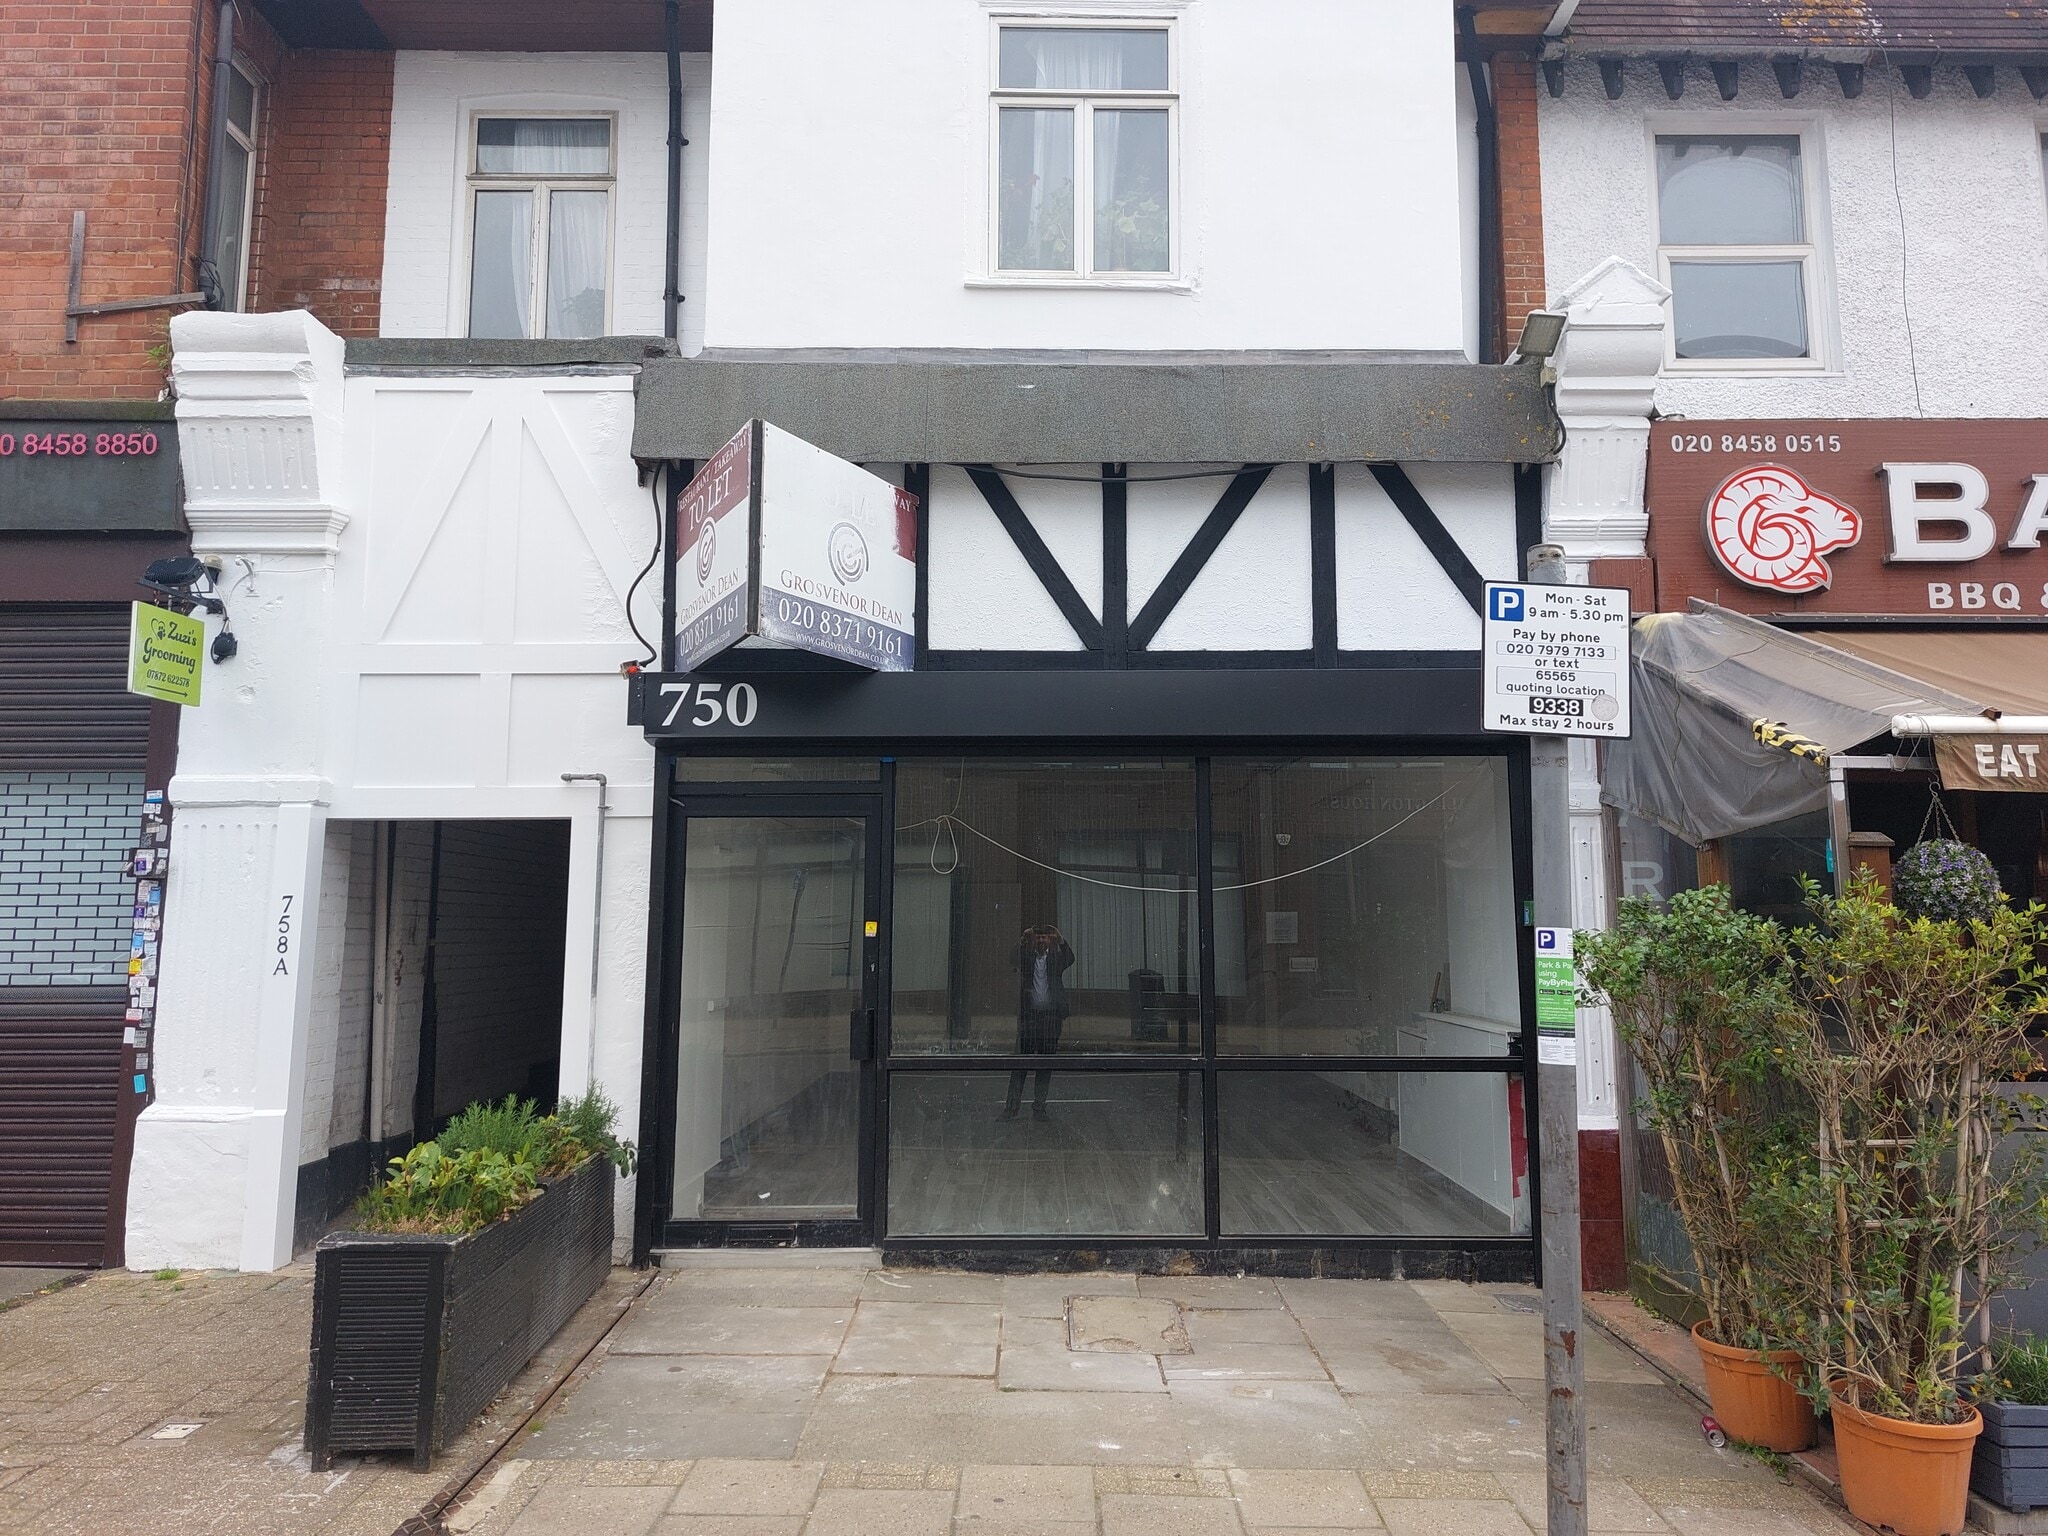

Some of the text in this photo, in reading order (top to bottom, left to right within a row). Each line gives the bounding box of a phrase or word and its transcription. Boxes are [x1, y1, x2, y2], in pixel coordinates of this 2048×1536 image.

[22, 433, 87, 455] 8458
[95, 433, 158, 455] 8850
[1671, 434, 1841, 453] 020 8458 0515
[689, 466, 733, 531] TO LET
[680, 568, 739, 625] GROSVENOR DEAN
[780, 569, 903, 626] GROSVENOR DEAN
[1498, 591, 1520, 618] P
[1545, 593, 1573, 605] Mon
[1584, 595, 1607, 606] Sat
[1927, 582, 2022, 611] BBQ
[1529, 607, 1536, 617] 9
[1540, 609, 1559, 618] am
[1570, 609, 1601, 621] 5.30
[1604, 612, 1624, 623] pm
[167, 621, 198, 646] Zuzi's
[680, 594, 739, 657] 020 8371 9161
[779, 598, 902, 657] 020 8371 9161
[1513, 629, 1601, 643] Pay by phone
[143, 637, 196, 675] Grooming
[1506, 643, 1605, 658] 020 7979 7133
[1535, 658, 1580, 669] or text
[146, 668, 167, 682] 07872
[1536, 671, 1576, 682] 65565
[1506, 683, 1606, 696] quoting location
[659, 682, 758, 727] 750
[1533, 698, 1580, 715] 9338
[1500, 714, 1614, 731] Max stay 2 hours
[1974, 744, 2040, 778] EAT
[272, 895, 294, 975] 758A
[1540, 932, 1552, 946] P
[1539, 961, 1554, 969] Park
[1539, 970, 1557, 978] using
